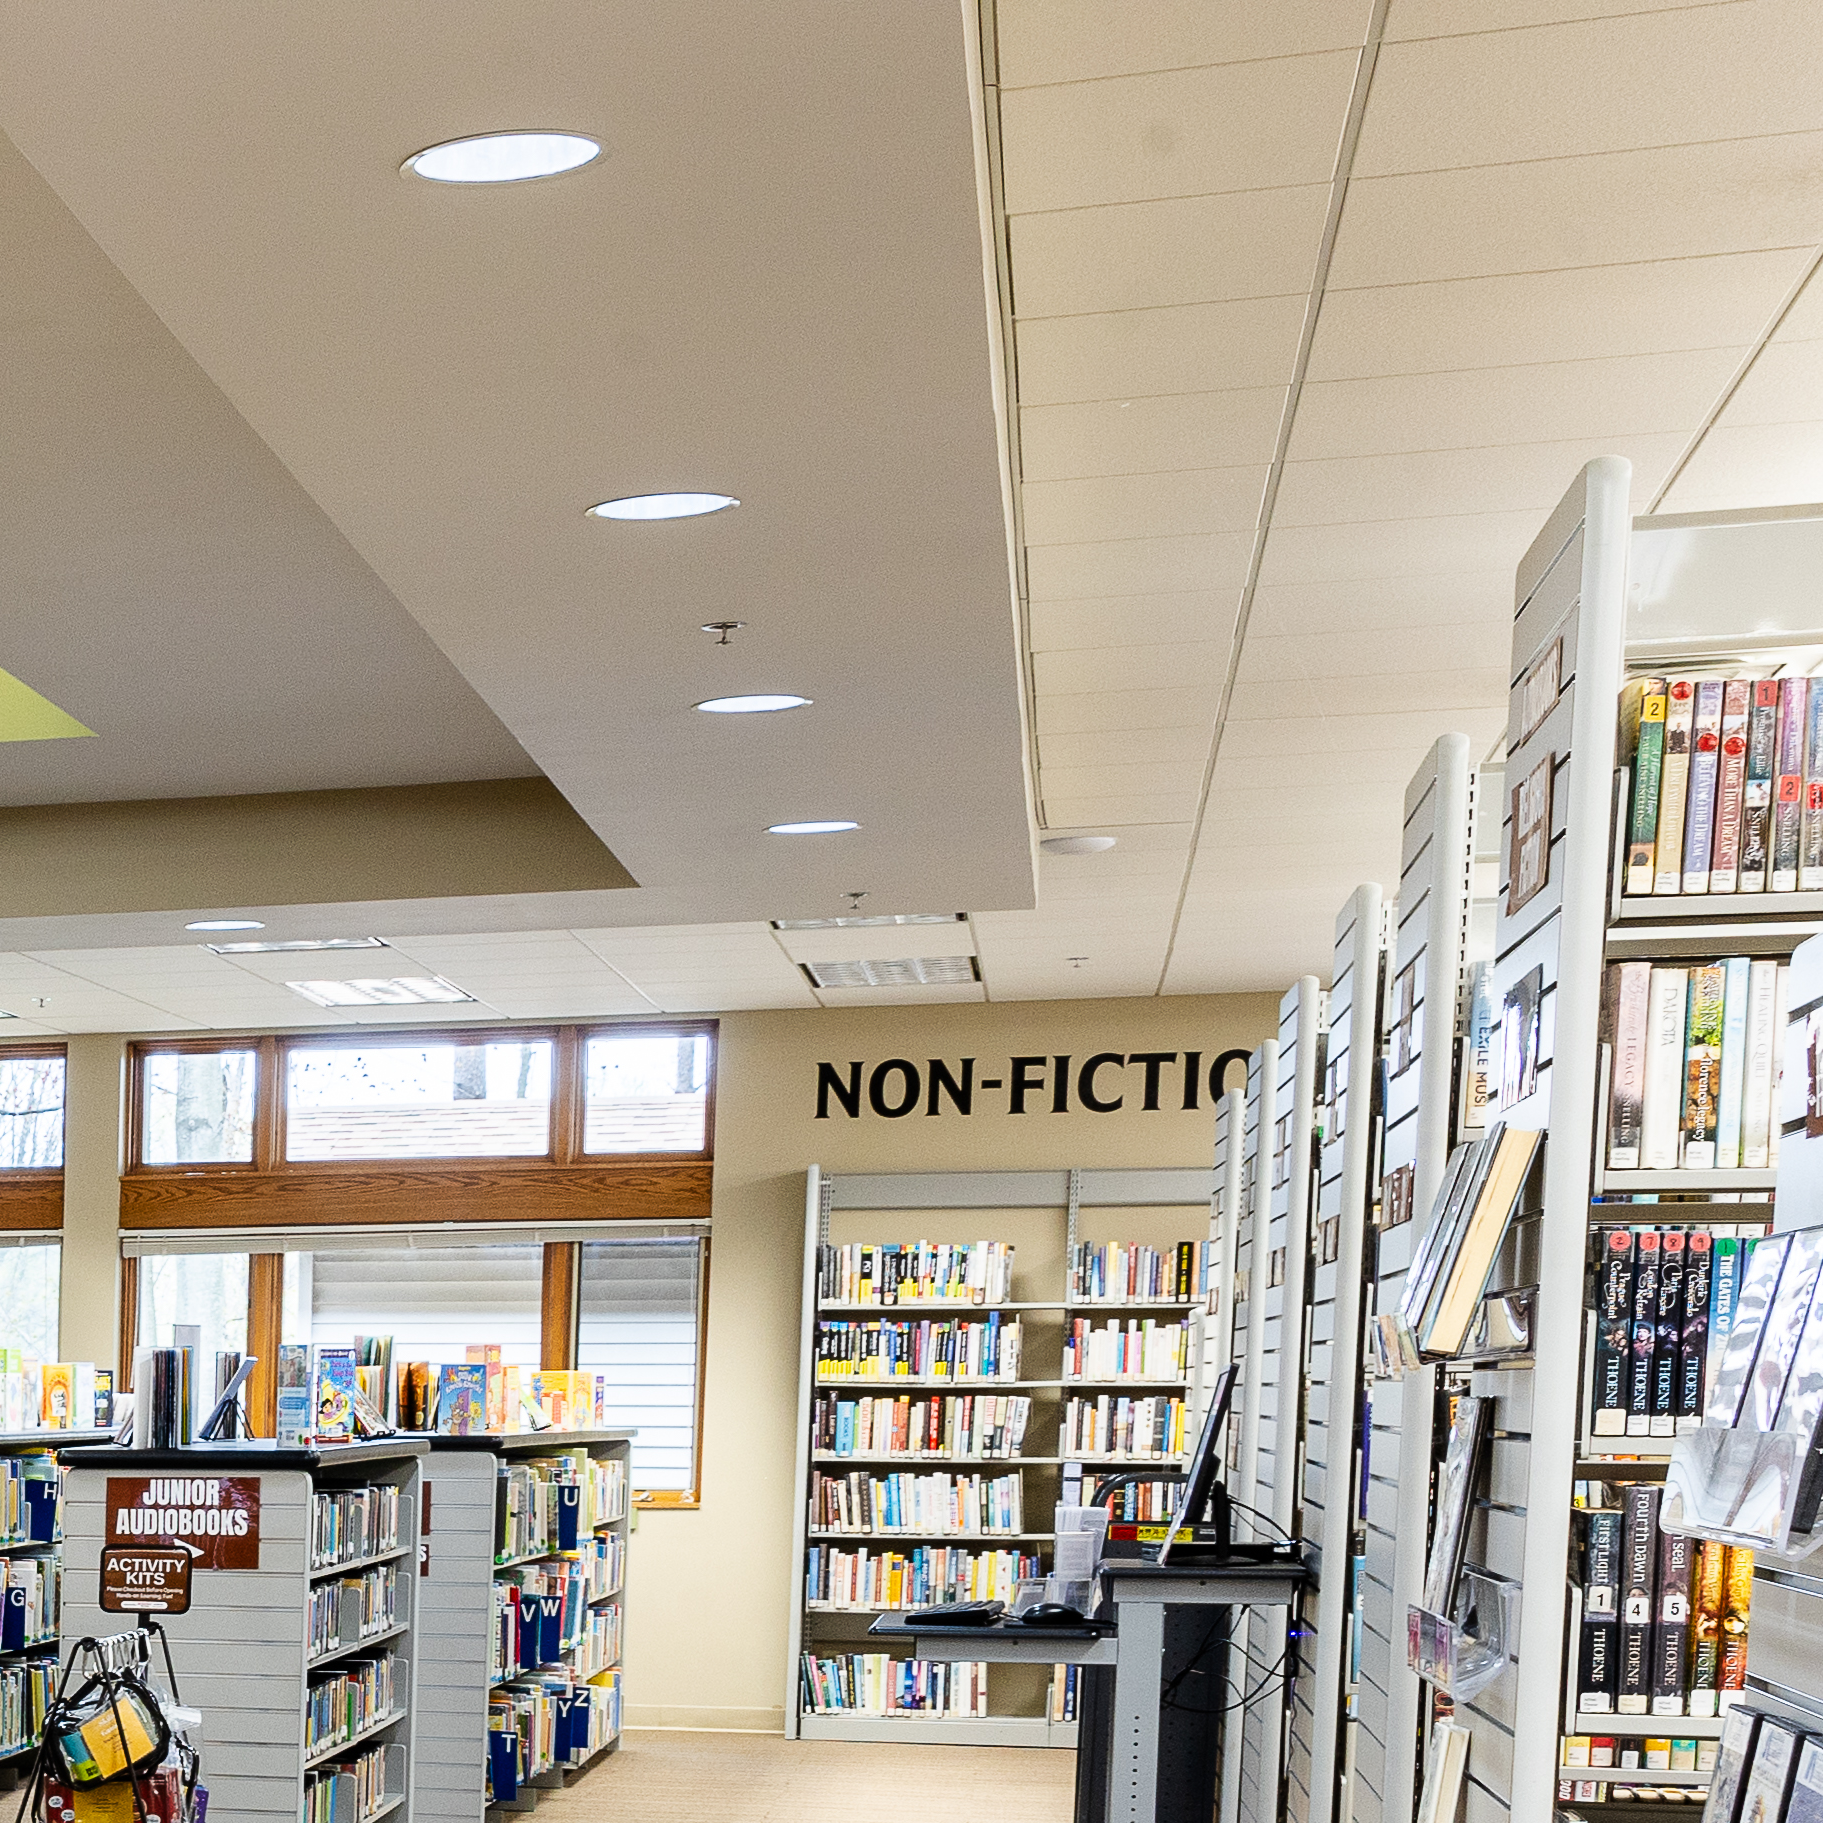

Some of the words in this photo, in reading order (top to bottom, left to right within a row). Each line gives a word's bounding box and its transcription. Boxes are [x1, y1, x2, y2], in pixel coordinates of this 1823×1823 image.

[1778, 805, 1792, 857] SNELLING
[1661, 988, 1678, 1047] DAKOTA
[1624, 1036, 1637, 1088] LEGACY
[815, 1048, 1254, 1119] NON-FICTIO
[1621, 1093, 1631, 1144] SNELLING
[1721, 1254, 1734, 1277] THE
[1717, 1281, 1733, 1315] GATES
[1717, 1317, 1729, 1332] OF
[1605, 1356, 1620, 1408] THOENE
[1633, 1358, 1648, 1410] THOENE
[1657, 1357, 1672, 1410] THOENE
[1684, 1357, 1699, 1409] THOENE
[44, 1482, 57, 1500] H
[143, 1479, 220, 1506] JUNIOR
[563, 1488, 579, 1506] U
[116, 1508, 249, 1536] AUDIOBOOKS
[106, 1558, 185, 1573] ACTIVITY
[126, 1572, 165, 1585] KITS
[10, 1589, 25, 1608] G
[540, 1599, 560, 1617] W
[520, 1604, 536, 1623] V
[1591, 1629, 1606, 1683] THOENE
[1627, 1632, 1641, 1686] THOENE
[1665, 1632, 1678, 1686] THOENE
[559, 1701, 572, 1718] Y
[574, 1689, 590, 1707] Z
[501, 1734, 516, 1753] T
